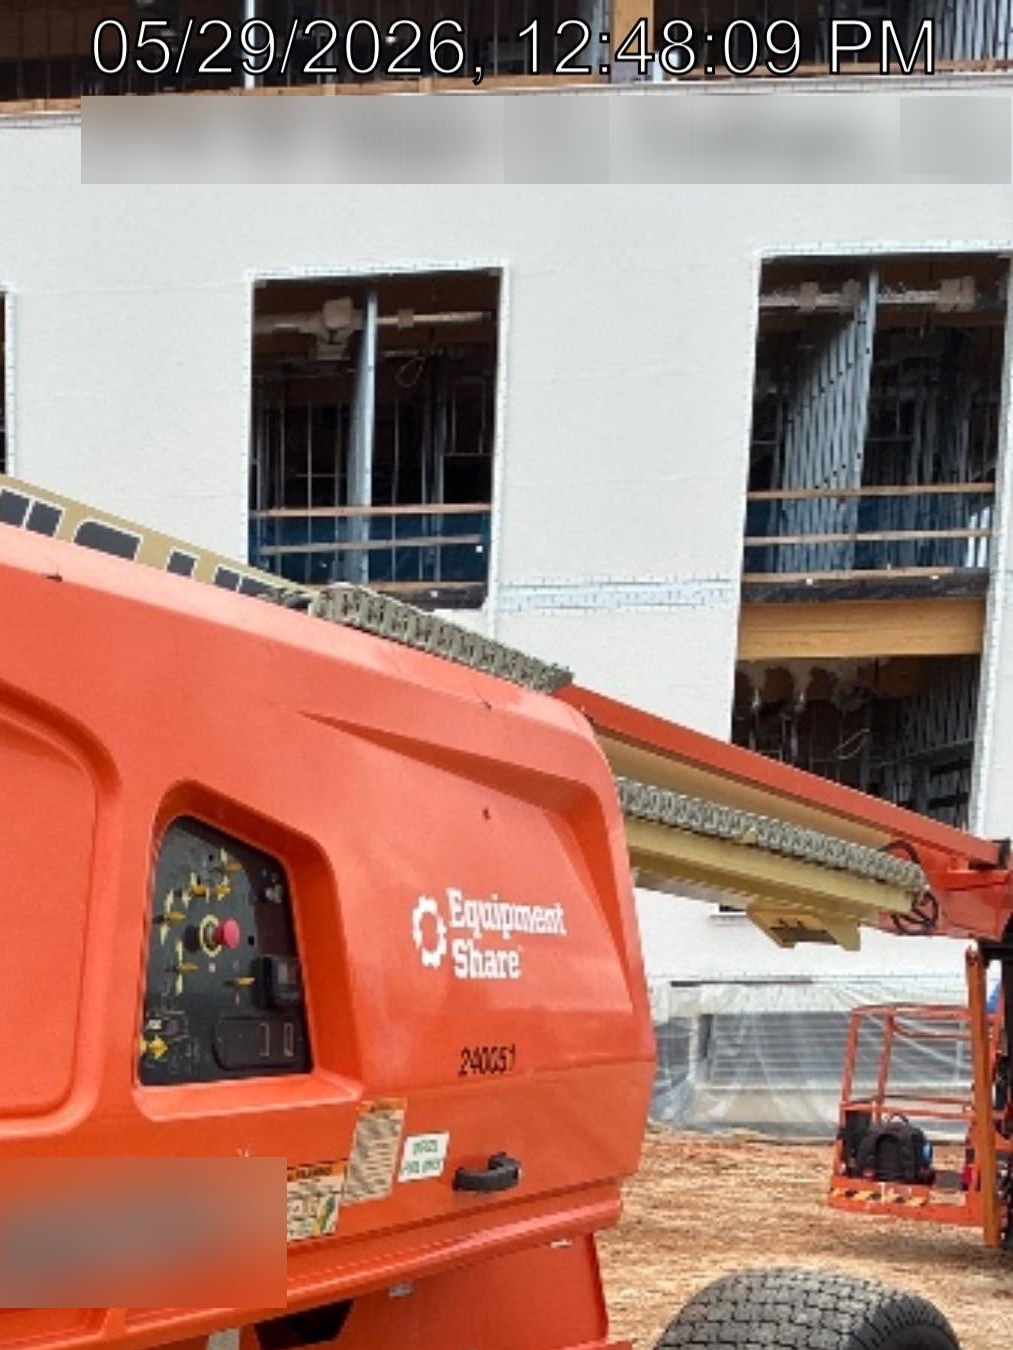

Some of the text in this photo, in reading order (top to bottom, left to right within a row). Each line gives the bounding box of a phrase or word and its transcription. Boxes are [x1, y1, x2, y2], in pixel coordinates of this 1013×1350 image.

[446, 887, 567, 940] Equipment
[451, 938, 522, 979] Share
[458, 1044, 517, 1077] 240051
